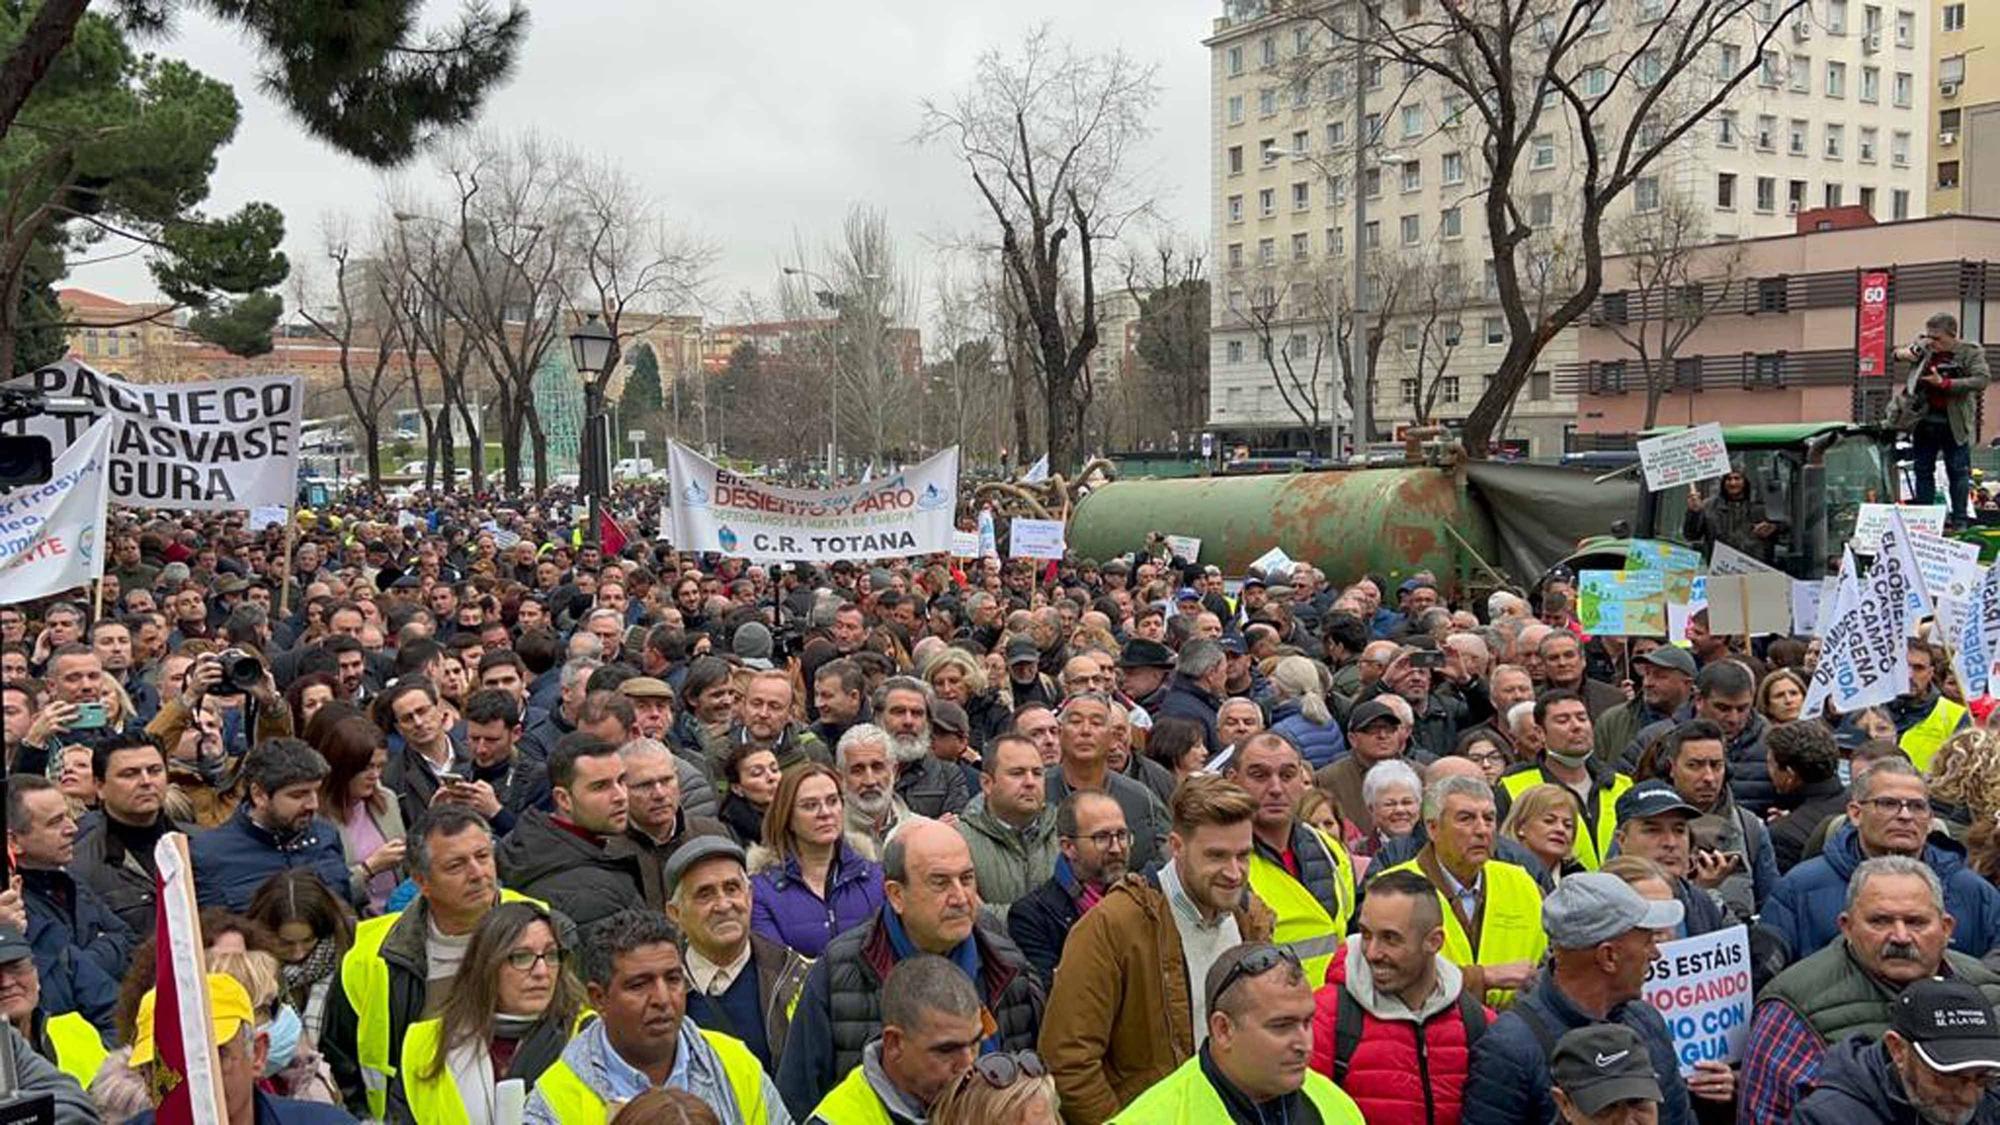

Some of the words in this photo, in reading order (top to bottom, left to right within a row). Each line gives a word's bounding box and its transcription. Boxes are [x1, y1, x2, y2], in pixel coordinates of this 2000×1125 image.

[1864, 287, 1884, 303] 60
[34, 368, 291, 424] PACHECO
[753, 534, 802, 554] C.R.
[812, 530, 916, 554] TOTANA
[1882, 531, 1896, 555] EL
[1860, 599, 1892, 674] CAMPO
[1676, 943, 1741, 977] ESTÁIS
[1702, 1002, 1745, 1035] CON
[1681, 1035, 1729, 1065] GUA
